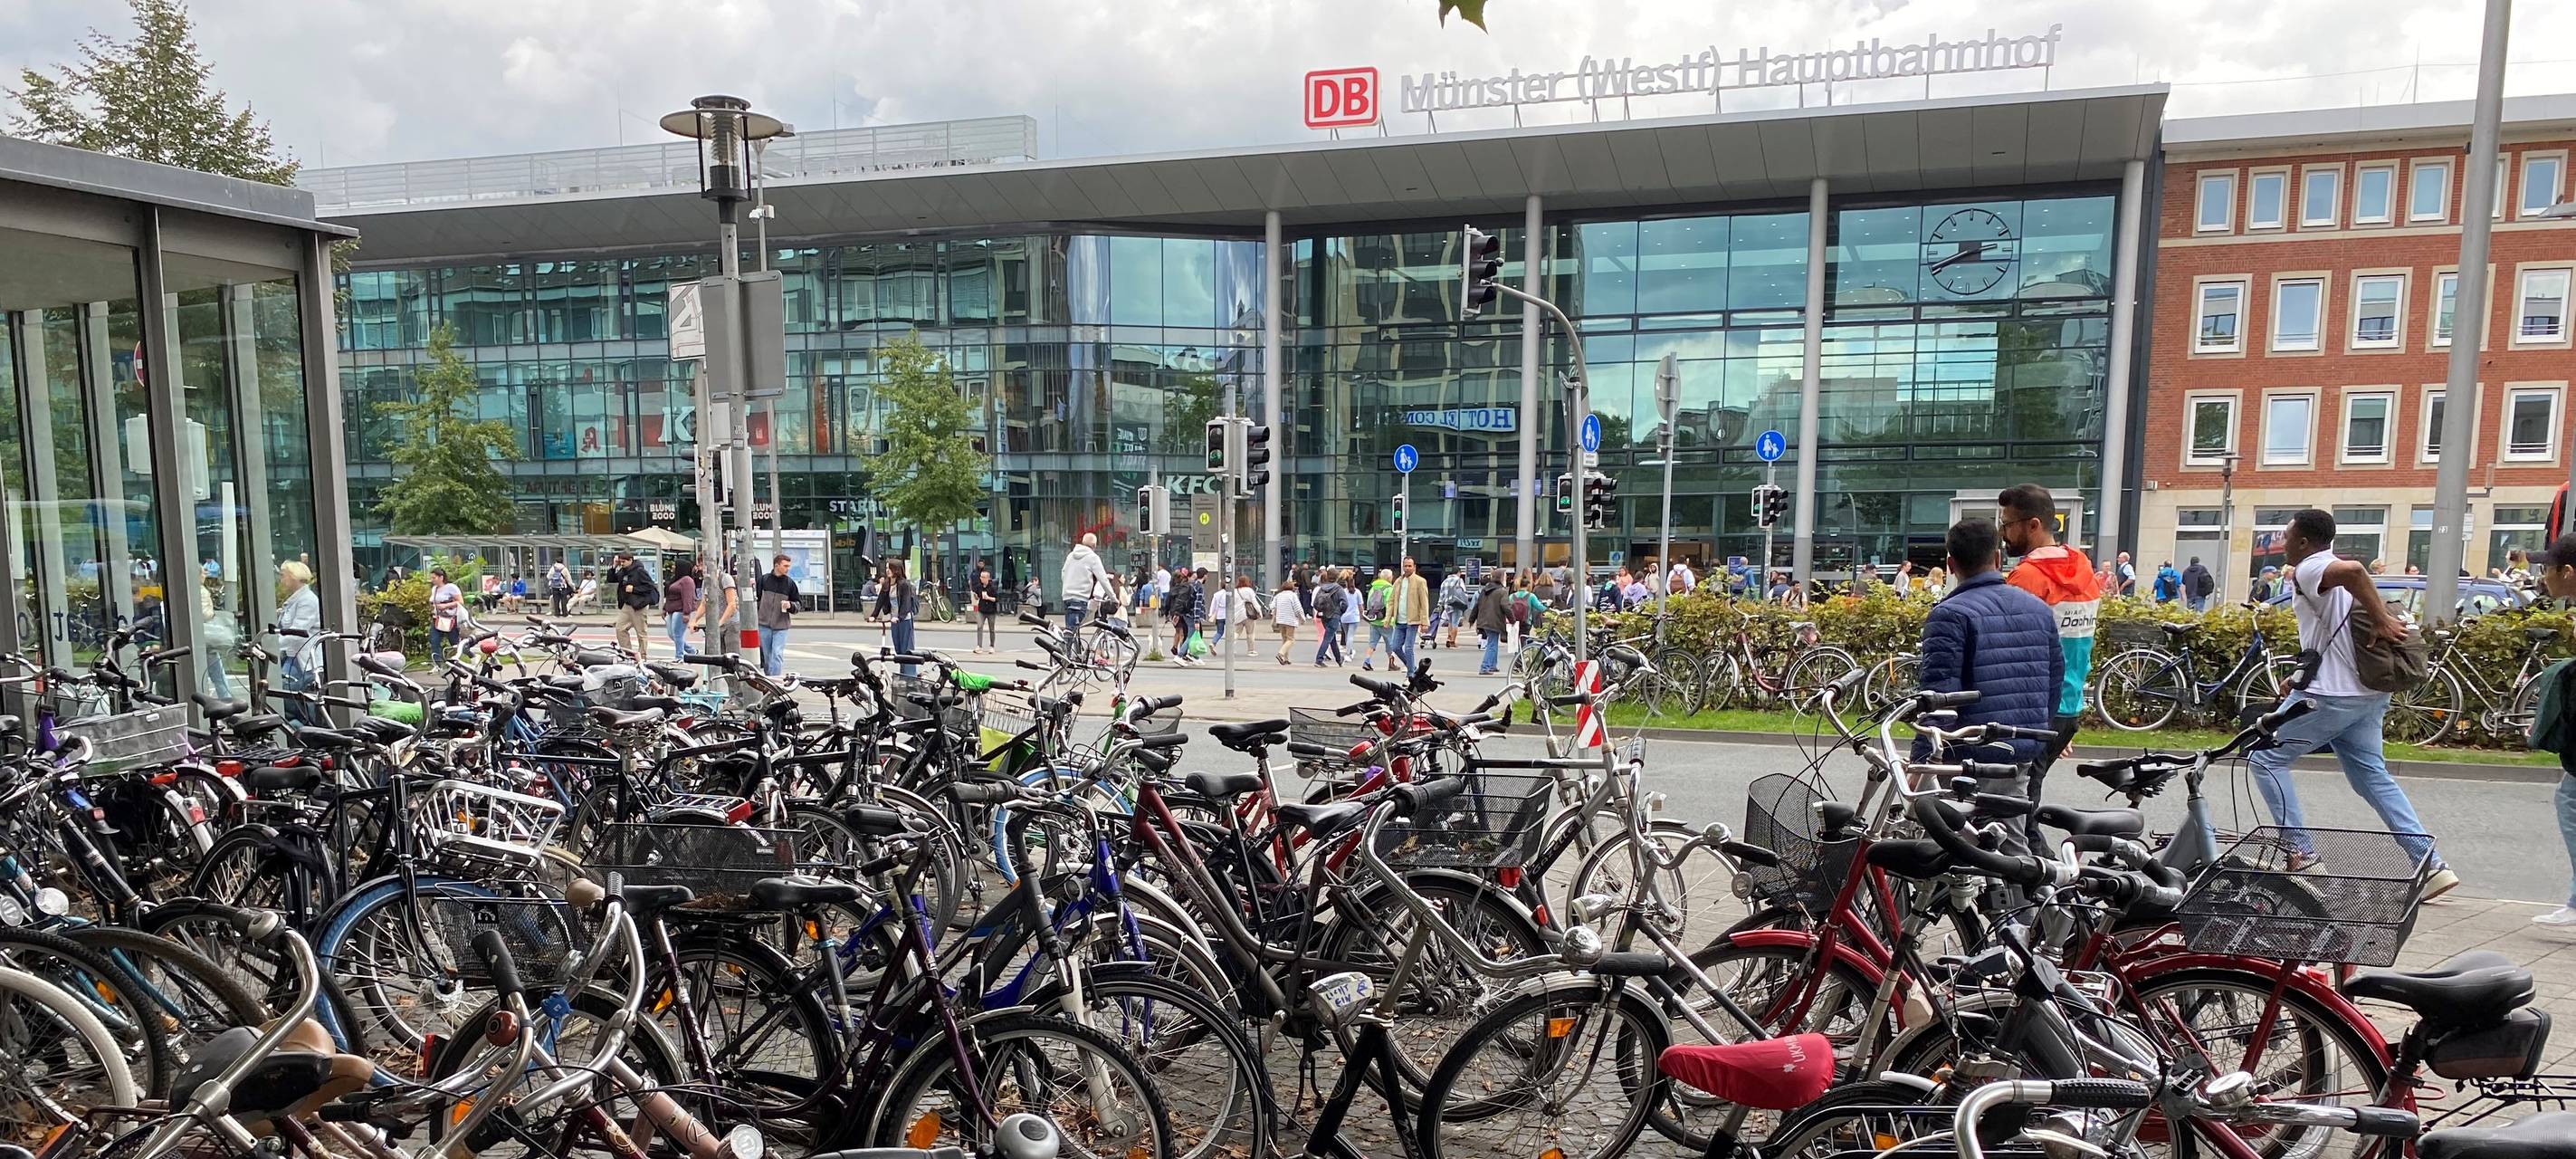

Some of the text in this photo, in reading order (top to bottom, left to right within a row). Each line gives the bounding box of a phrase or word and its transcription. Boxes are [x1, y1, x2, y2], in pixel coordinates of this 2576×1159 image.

[1400, 24, 2063, 113] Münster (Westf) Hauptbahnhof
[1312, 77, 1370, 119] DB
[1165, 475, 1221, 494] KFC
[1335, 994, 1350, 1007] EIN
